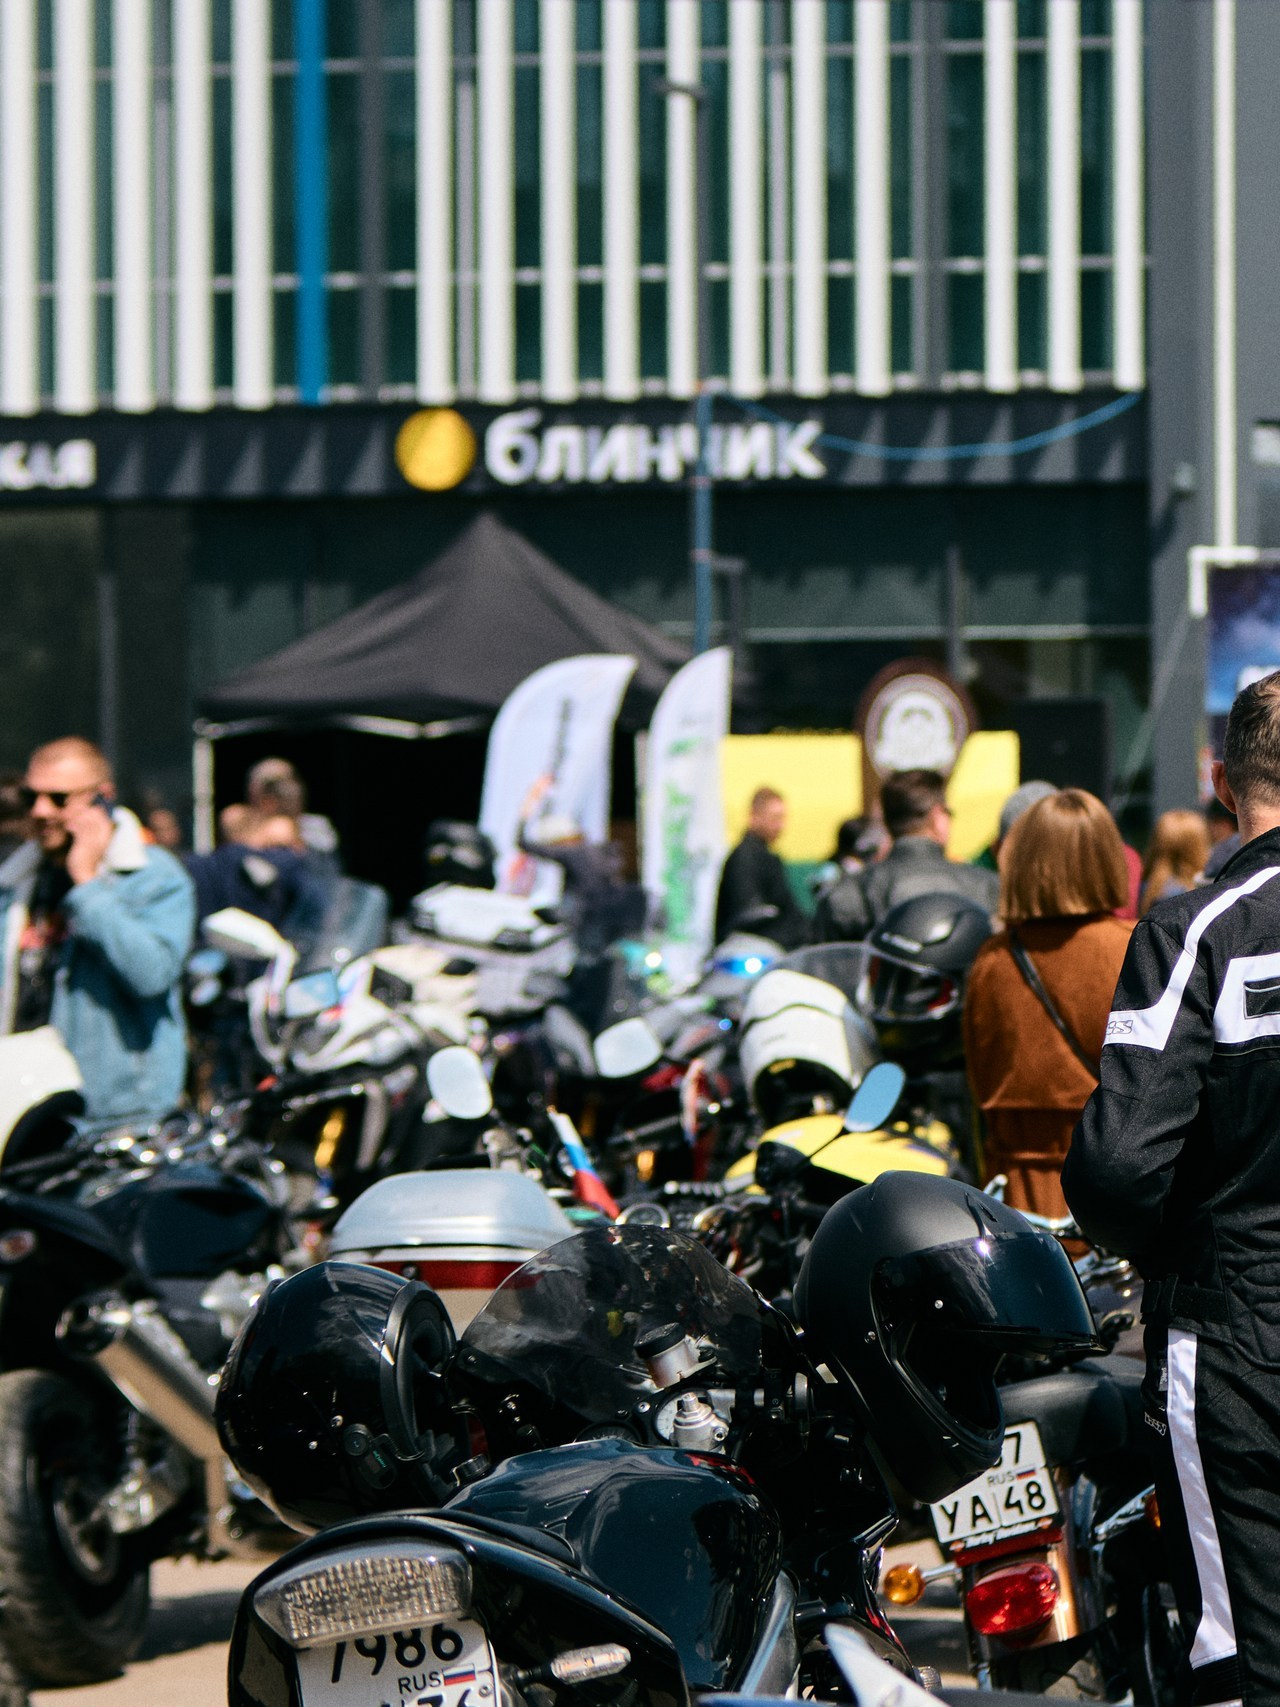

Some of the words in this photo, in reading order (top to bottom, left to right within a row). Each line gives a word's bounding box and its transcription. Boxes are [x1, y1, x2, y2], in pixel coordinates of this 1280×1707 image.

[987, 1470, 1016, 1488] RUS
[1004, 1480, 1046, 1516] 48
[398, 1670, 442, 1695] RUS
